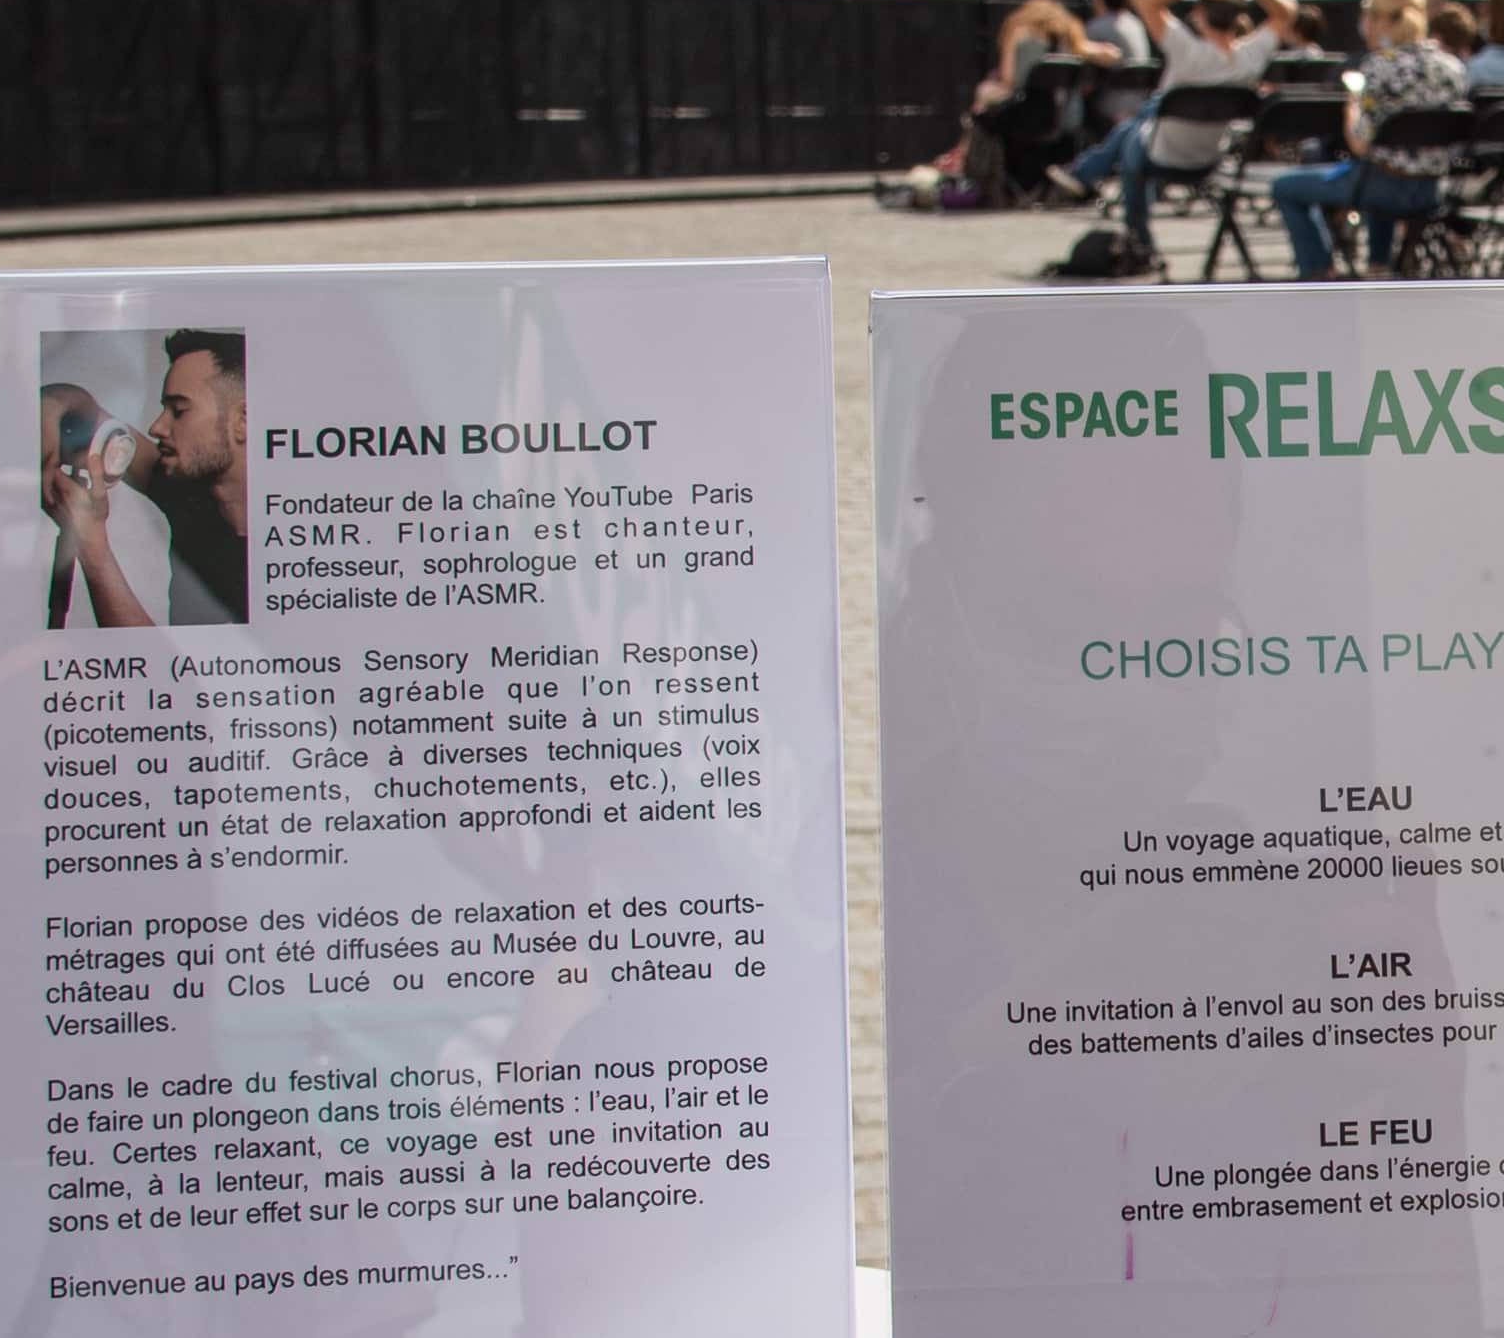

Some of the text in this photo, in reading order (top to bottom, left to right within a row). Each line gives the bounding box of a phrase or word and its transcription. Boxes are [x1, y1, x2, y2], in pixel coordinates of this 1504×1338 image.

[990, 390, 1178, 440] ESPACE
[266, 420, 657, 459] FLORIAN BOULLOT
[266, 483, 753, 516] Fondateur de la chaîne YouTube Paris
[264, 517, 752, 547] ASMR. Florian est chanteur,
[266, 545, 754, 584] professeur, sophrologue et un grand
[266, 582, 544, 616] spécialiste de l'ASMR.
[44, 639, 758, 683] L'ASMR (Autonomous Sensory Meridian Response)
[1080, 636, 1291, 681] CHOISIS
[1306, 635, 1368, 673] TA
[43, 672, 760, 713] décrit la sensation agréable que l'on ressent
[44, 703, 759, 751] (picotements, frissons) notamment suite à un stimulus
[44, 734, 760, 777] visuel ou auditif. Grâce à diverses techniques (voix
[44, 766, 760, 810] douces, tapotements, chuchotements, etc.), elles
[1320, 785, 1412, 812] L'EAU
[1124, 830, 1157, 852] Un
[1166, 833, 1254, 856] voyage
[1264, 825, 1390, 853] aquatique,
[1400, 822, 1471, 844] calme
[1480, 821, 1503, 842] et
[1080, 864, 1116, 891] qui
[1125, 867, 1184, 885] nous
[1192, 859, 1299, 883] emmène
[1307, 856, 1383, 879] 20000
[1392, 855, 1462, 877] lieues
[1331, 952, 1413, 979] L'AIR
[45, 1011, 176, 1036] Versailles.
[1007, 1002, 1056, 1024] Une
[1066, 998, 1173, 1022] invitation
[1183, 997, 1197, 1018] à
[1206, 993, 1283, 1017] l'envol
[1292, 998, 1321, 1014] au
[1330, 996, 1373, 1013] son
[1382, 990, 1426, 1011] des
[1029, 1034, 1072, 1056] des
[1081, 1029, 1218, 1054] battements
[1226, 1026, 1304, 1049] d'ailes
[1312, 1023, 1434, 1046] d'insectes
[1443, 1024, 1497, 1047] pour
[1320, 1118, 1432, 1147] LE FEU
[1155, 1165, 1205, 1188] Une
[1214, 1161, 1312, 1191] plongée
[1320, 1159, 1379, 1181] dans
[1388, 1155, 1491, 1182] l'énergie
[1121, 1200, 1184, 1223] entre
[1192, 1192, 1362, 1219] embrasement
[1369, 1191, 1392, 1212] et
